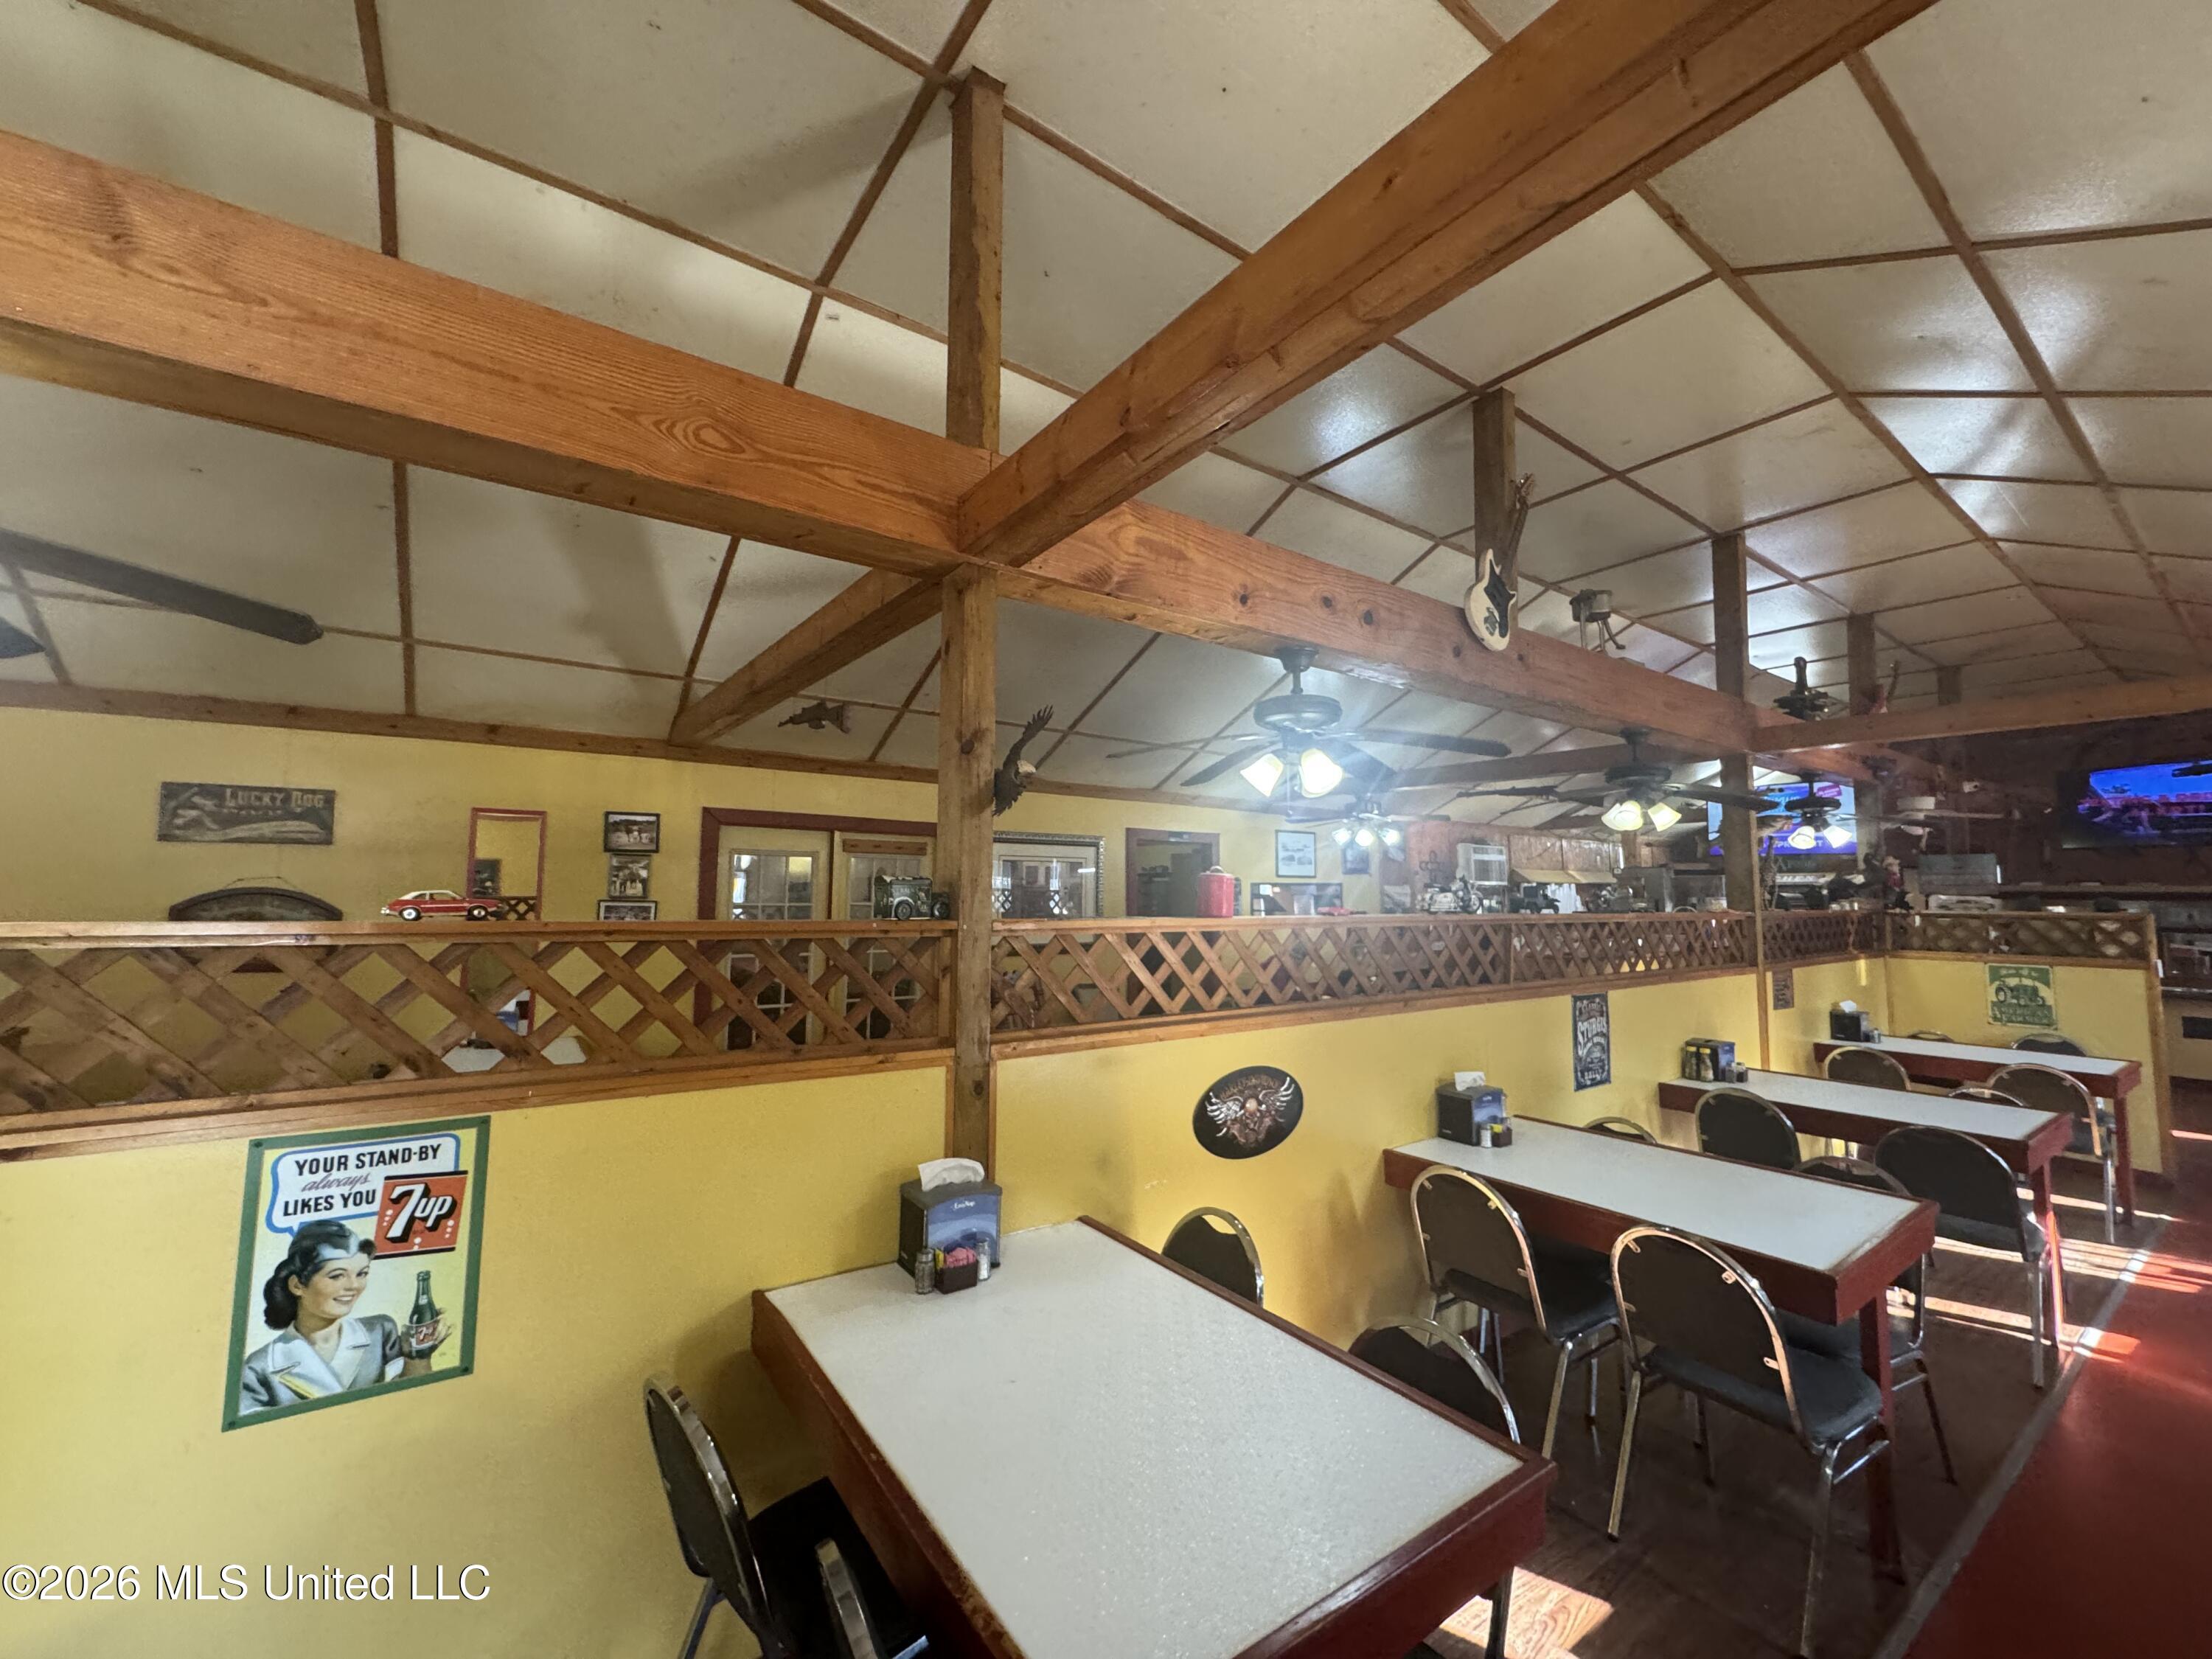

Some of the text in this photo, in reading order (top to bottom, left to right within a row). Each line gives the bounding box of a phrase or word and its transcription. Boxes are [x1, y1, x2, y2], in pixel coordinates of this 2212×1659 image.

[225, 788, 285, 807] LUCKY
[294, 1144, 442, 1176] YOUR STAND-BY
[301, 1172, 371, 1192] always
[282, 1189, 377, 1217] LIKES YOU
